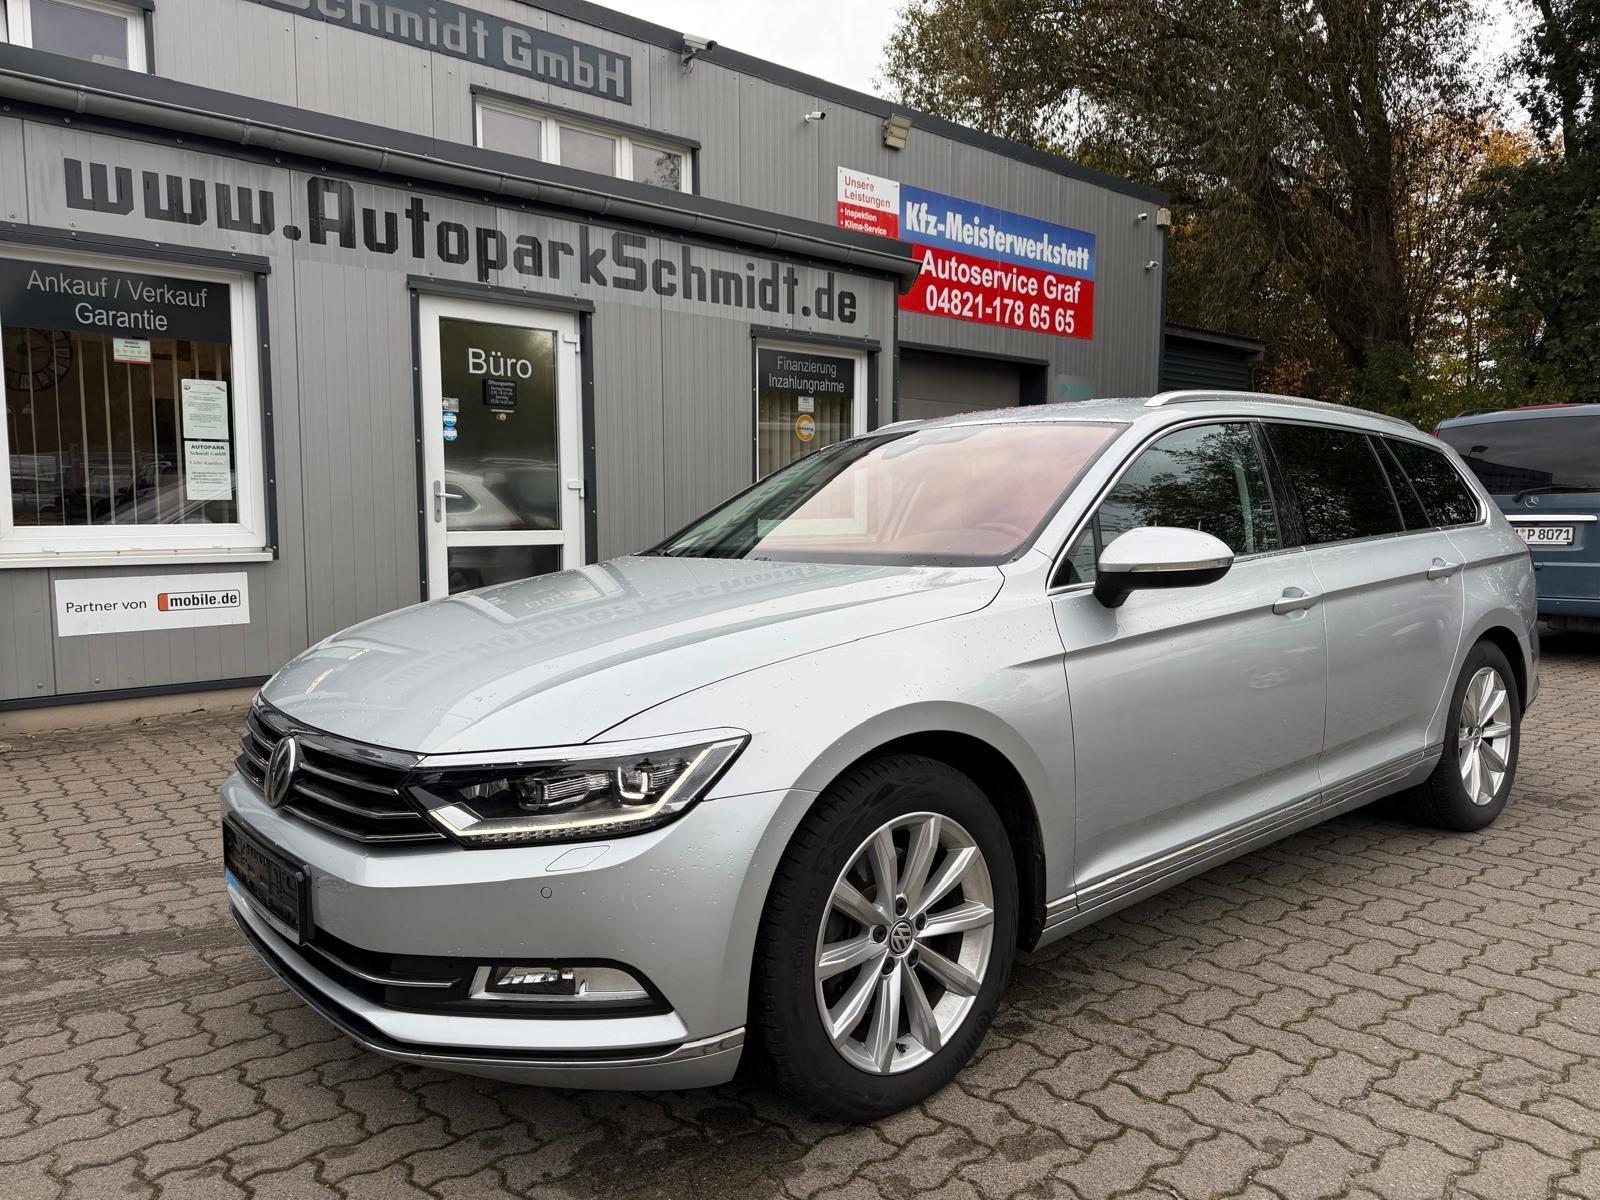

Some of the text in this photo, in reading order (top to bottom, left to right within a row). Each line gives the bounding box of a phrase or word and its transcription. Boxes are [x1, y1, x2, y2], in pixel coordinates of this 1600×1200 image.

[502, 25, 625, 98] GmbH
[844, 176, 875, 192] Unsere
[844, 188, 891, 209] Leistungen
[844, 208, 877, 222] Inspektion
[844, 220, 888, 236] Klima-Service
[63, 157, 857, 324] www.AutoparkSchmidt.de
[905, 201, 1089, 271] Kfz-Meisterwerkstatt
[26, 269, 208, 308] Ankauf / Verkauf
[920, 249, 1081, 304] Autoservice Graf
[74, 302, 169, 331] Garantie
[925, 284, 1075, 334] 04821-178 65 65
[467, 347, 533, 379] Büro
[777, 355, 837, 378] Finanzierung
[768, 372, 845, 394] Inzahlungnahme
[1537, 528, 1571, 541] 8071
[66, 592, 238, 613] Partner von mobile.de
